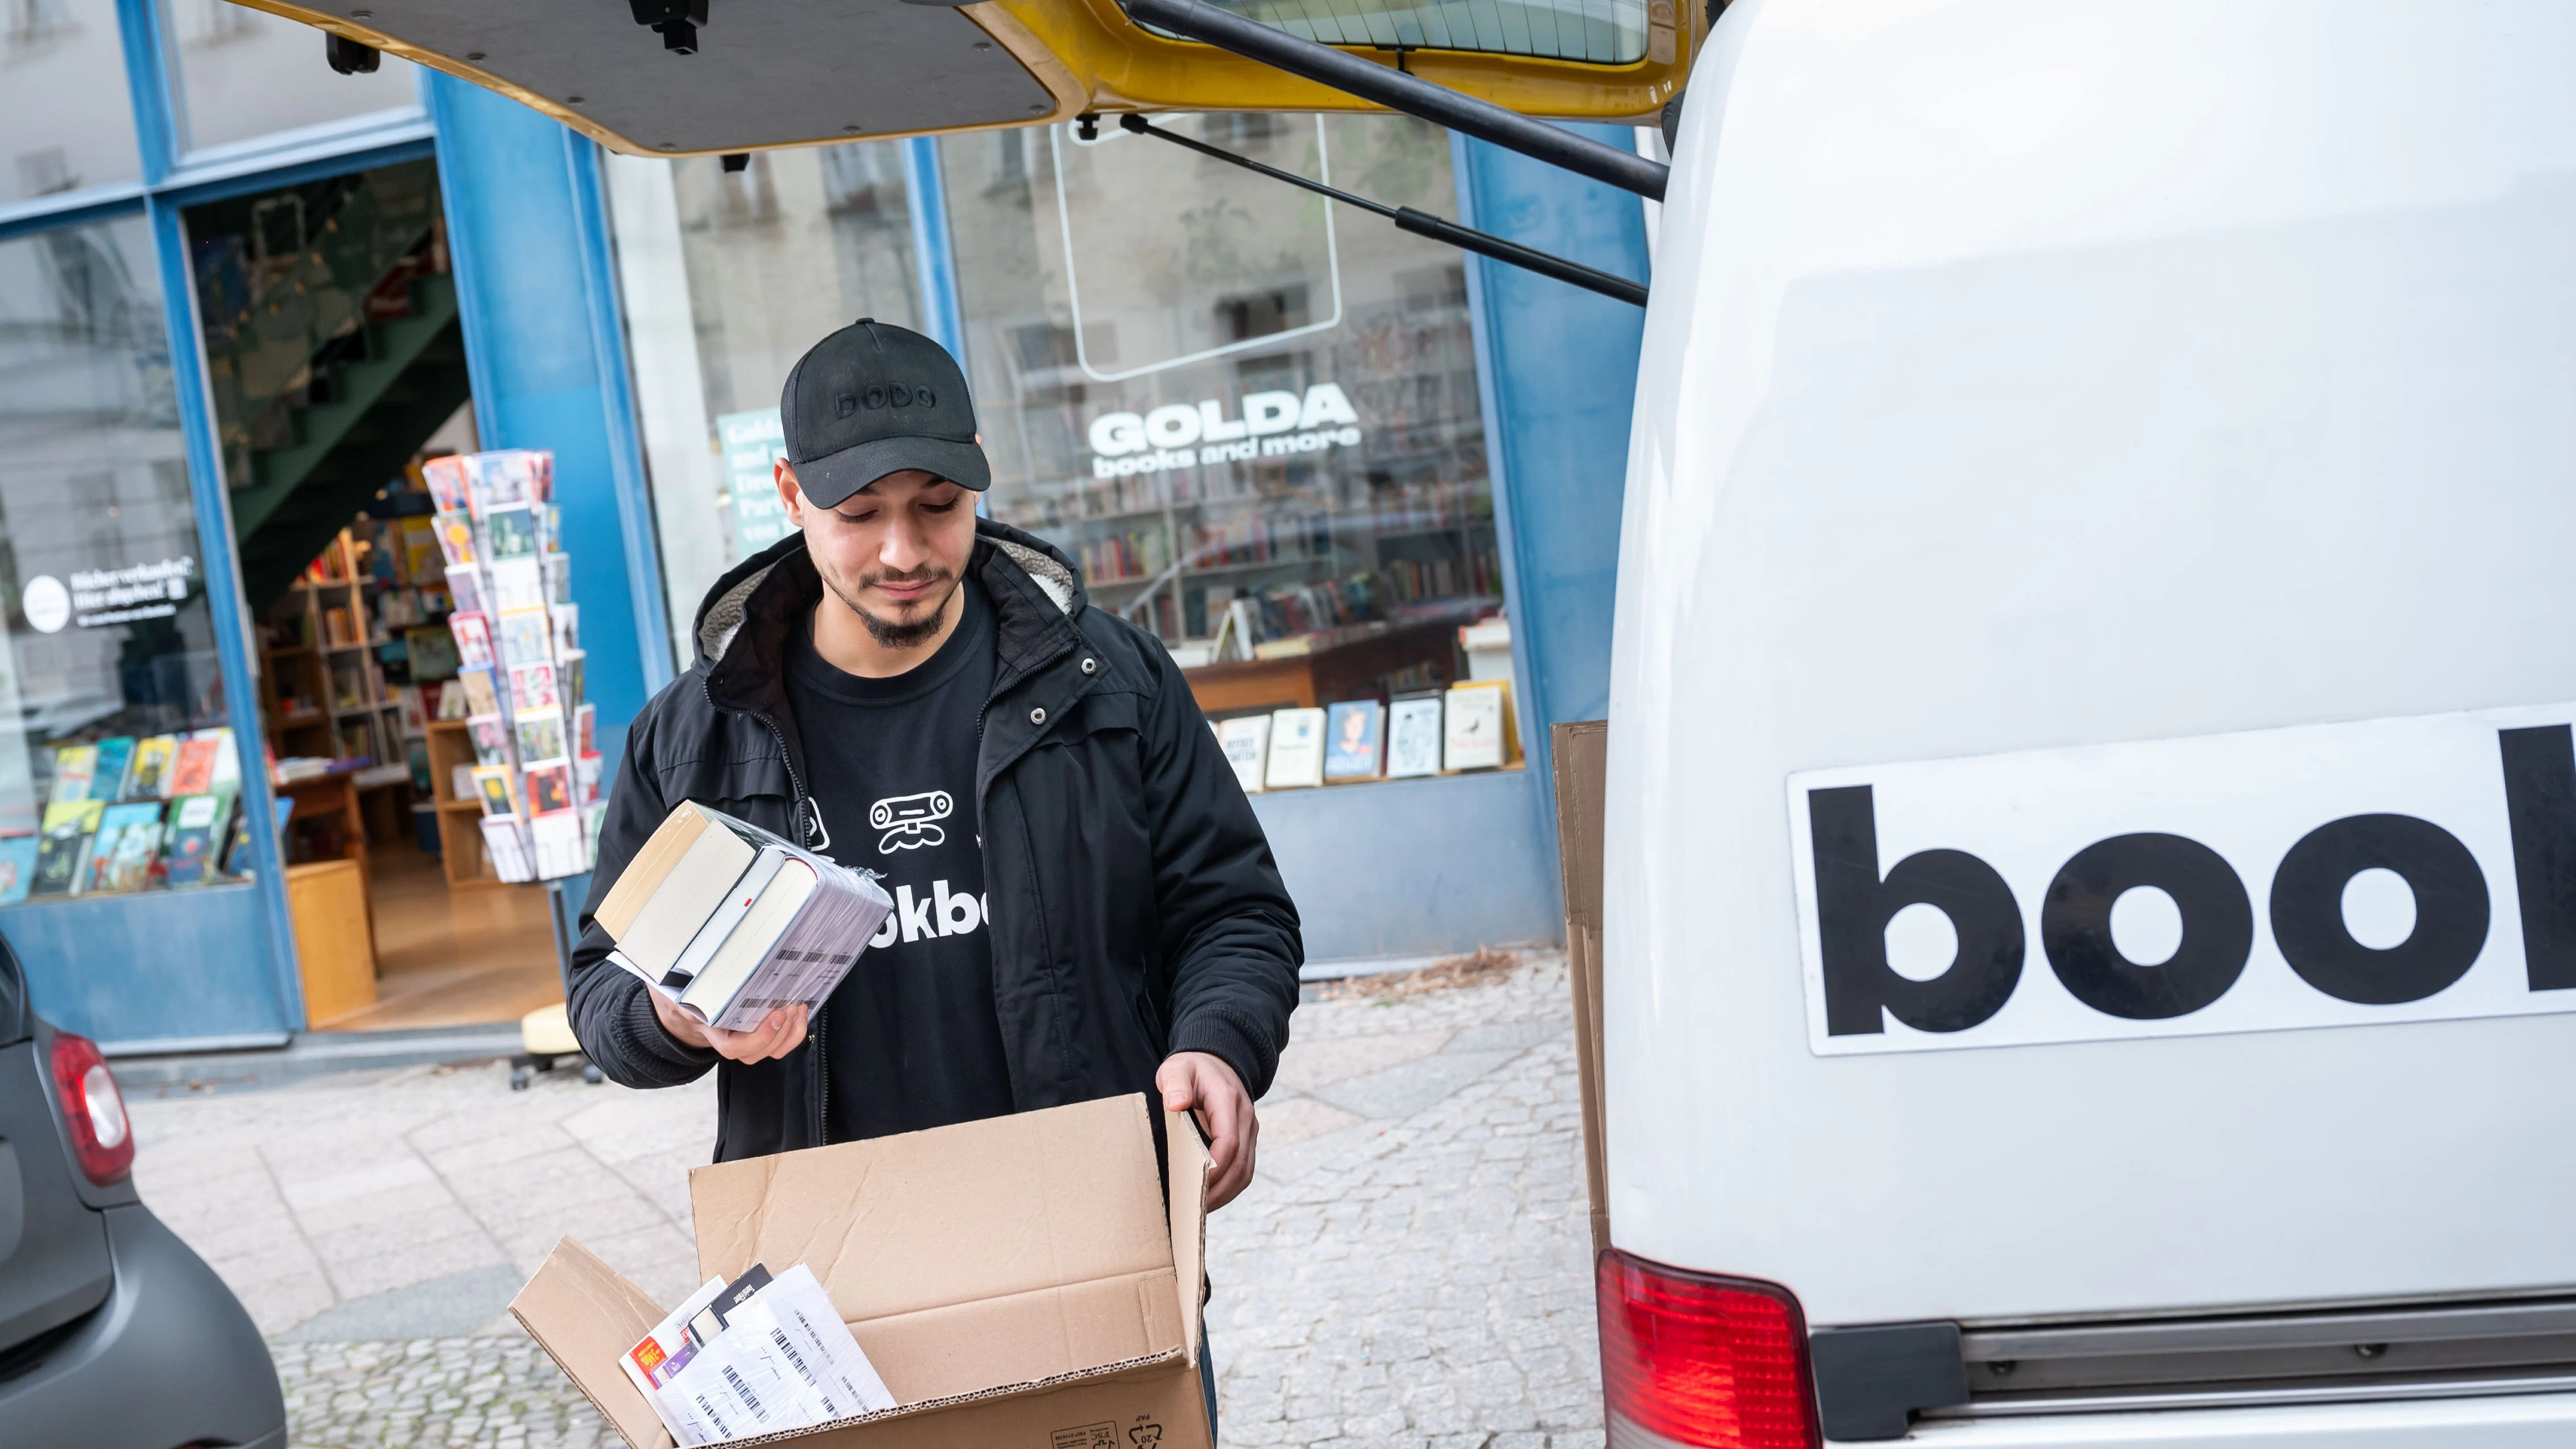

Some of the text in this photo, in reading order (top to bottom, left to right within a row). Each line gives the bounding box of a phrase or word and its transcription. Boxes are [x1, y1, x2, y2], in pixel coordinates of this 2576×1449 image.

[1088, 382, 1359, 456] GOLDA
[1092, 426, 1362, 479] books and more
[1136, 1414, 1150, 1422] PAP
[1141, 1434, 1153, 1444] 20
